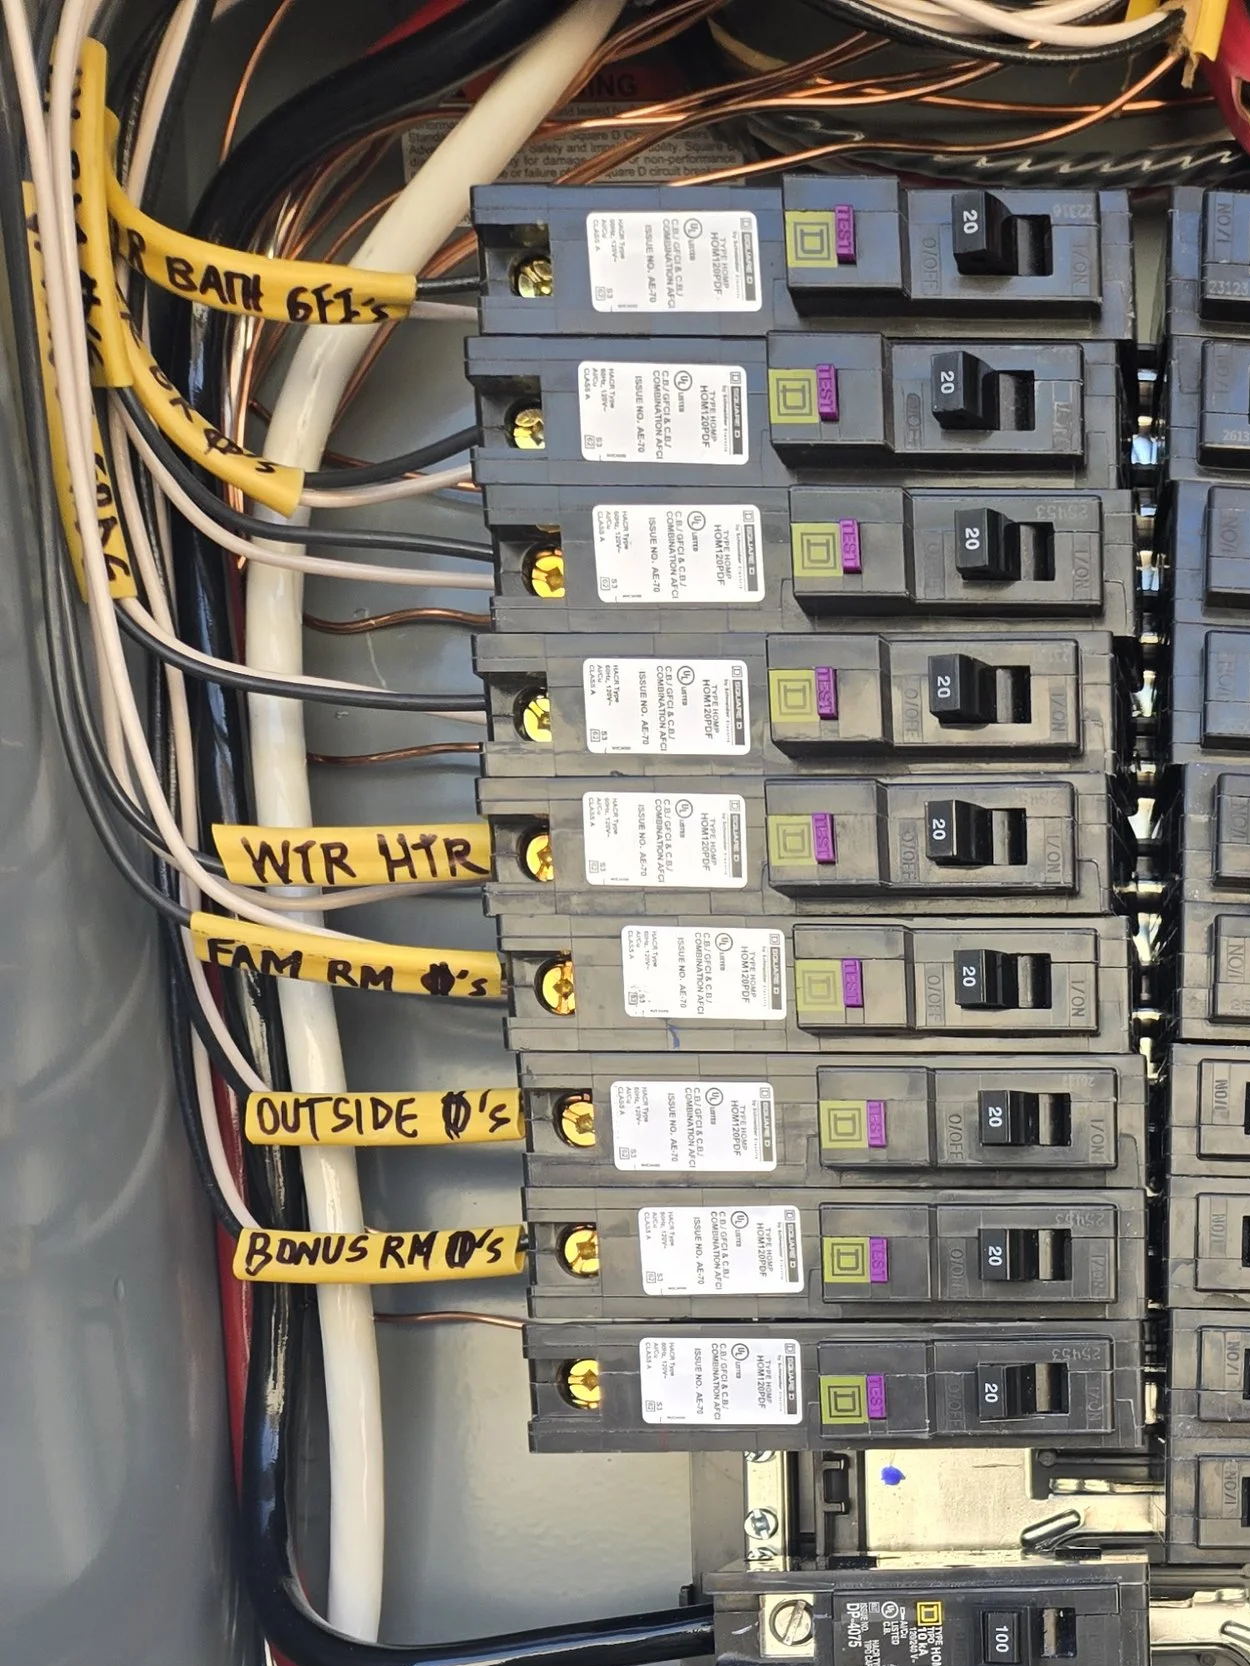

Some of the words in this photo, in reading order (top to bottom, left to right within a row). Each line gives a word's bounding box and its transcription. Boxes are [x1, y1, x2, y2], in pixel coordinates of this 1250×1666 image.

[836, 206, 853, 253] TEST
[962, 209, 978, 234] 20
[818, 365, 835, 411] TEST
[940, 370, 955, 394] 20
[648, 517, 657, 545] ISSUE
[666, 511, 678, 577] COMBINATION
[841, 520, 858, 564] TEST
[965, 528, 980, 550] 20
[714, 524, 725, 586] HOM120PDF
[652, 567, 660, 593] AE-70
[638, 671, 647, 699] ISSUE
[656, 666, 666, 729] COMBINATION
[816, 668, 834, 713] TEST
[937, 675, 950, 698] 20
[702, 679, 713, 739] HOM120PDF
[641, 720, 649, 745] AE-70
[700, 813, 710, 871] HOM120PDF
[813, 814, 832, 859] TEST
[932, 818, 946, 841] 20
[241, 836, 355, 885] WTR
[377, 832, 490, 882] HTR
[639, 851, 647, 876] AE-70
[843, 960, 860, 1005] TEST
[962, 966, 976, 987] 20
[257, 1097, 418, 1141] OUTSIDE
[868, 1102, 883, 1144] TEST
[988, 1106, 1002, 1128] 20
[245, 1232, 368, 1276] BONUS
[870, 1239, 886, 1282] TEST
[988, 1246, 1002, 1266] 20
[868, 1376, 884, 1416] TEST
[984, 1383, 998, 1403] 20
[846, 1603, 862, 1647] DP-4075
[891, 1621, 899, 1645] LISTED
[918, 1627, 927, 1641] 10
[934, 1626, 943, 1646] TYPE
[995, 1625, 1010, 1654] 100
